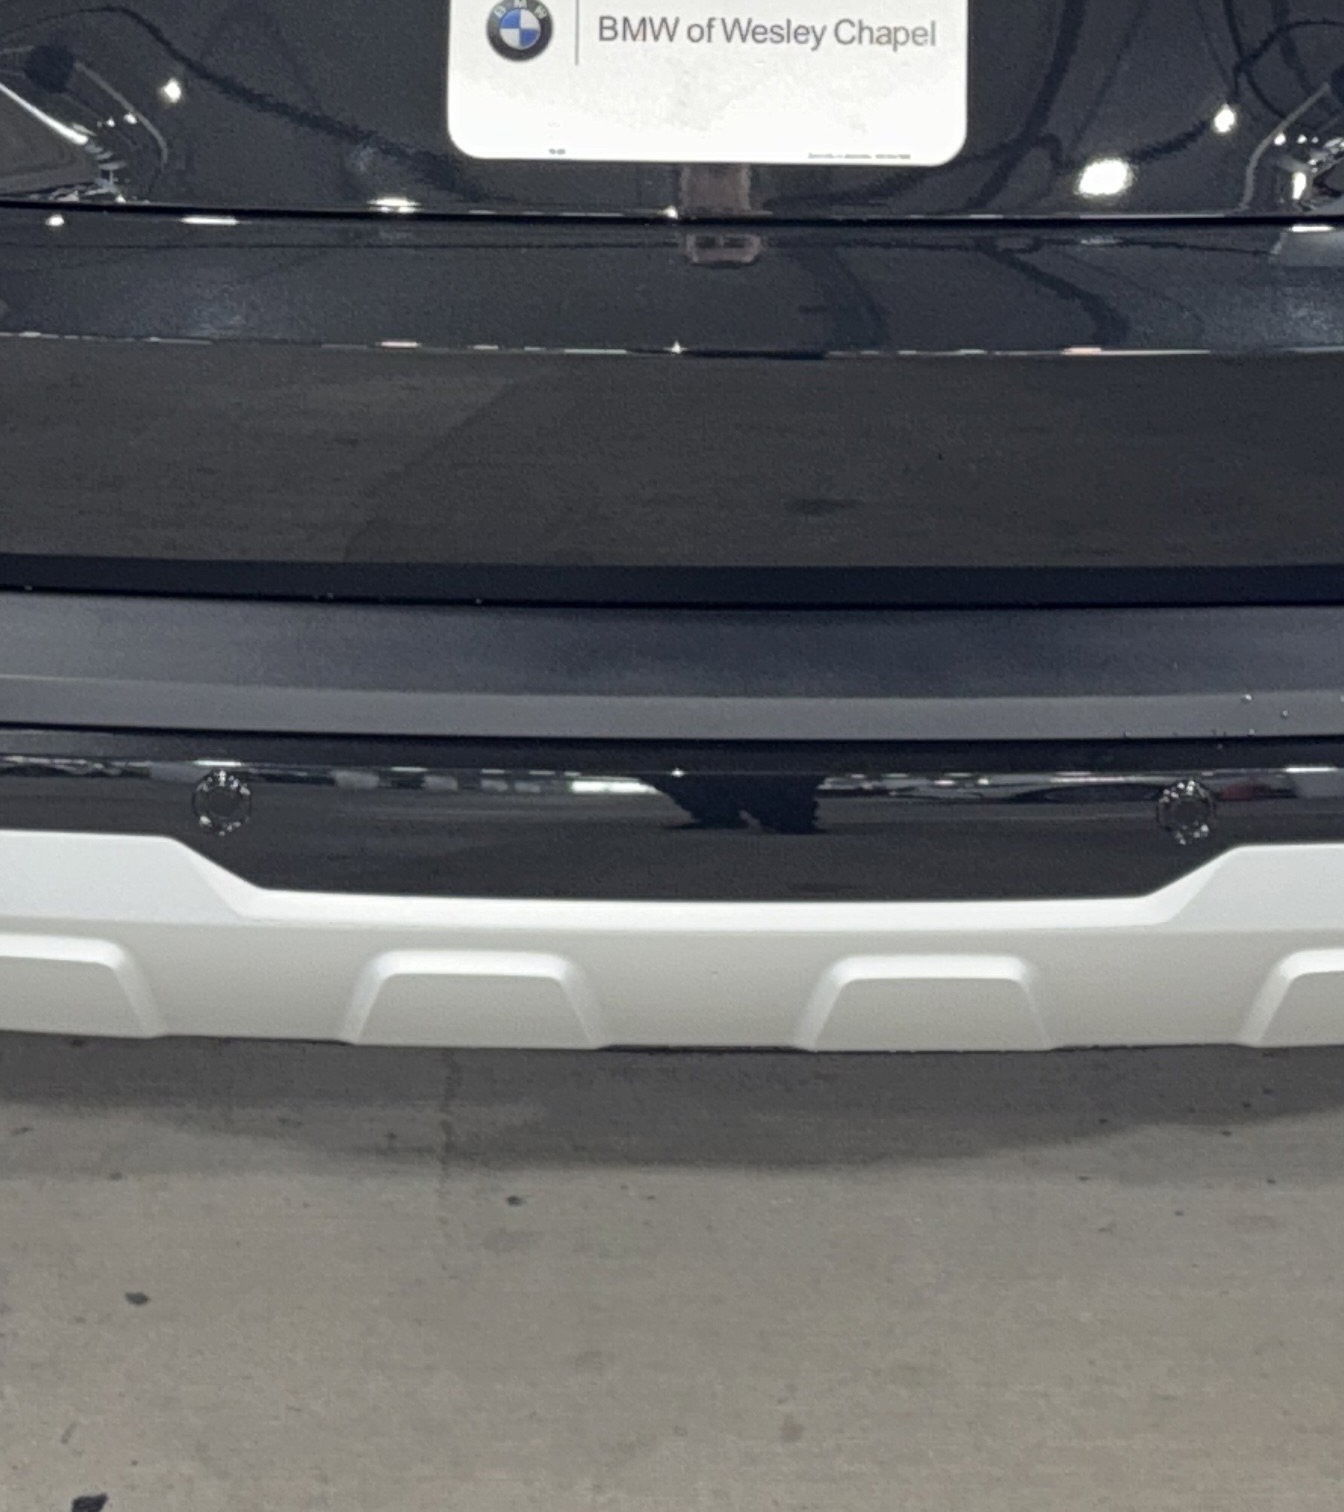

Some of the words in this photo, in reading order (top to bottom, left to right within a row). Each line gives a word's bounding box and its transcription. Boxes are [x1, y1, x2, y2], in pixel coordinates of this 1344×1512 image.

[599, 16, 680, 42] BMW
[687, 17, 716, 43] of
[721, 17, 827, 52] Wesley
[833, 18, 936, 52] Chapel
